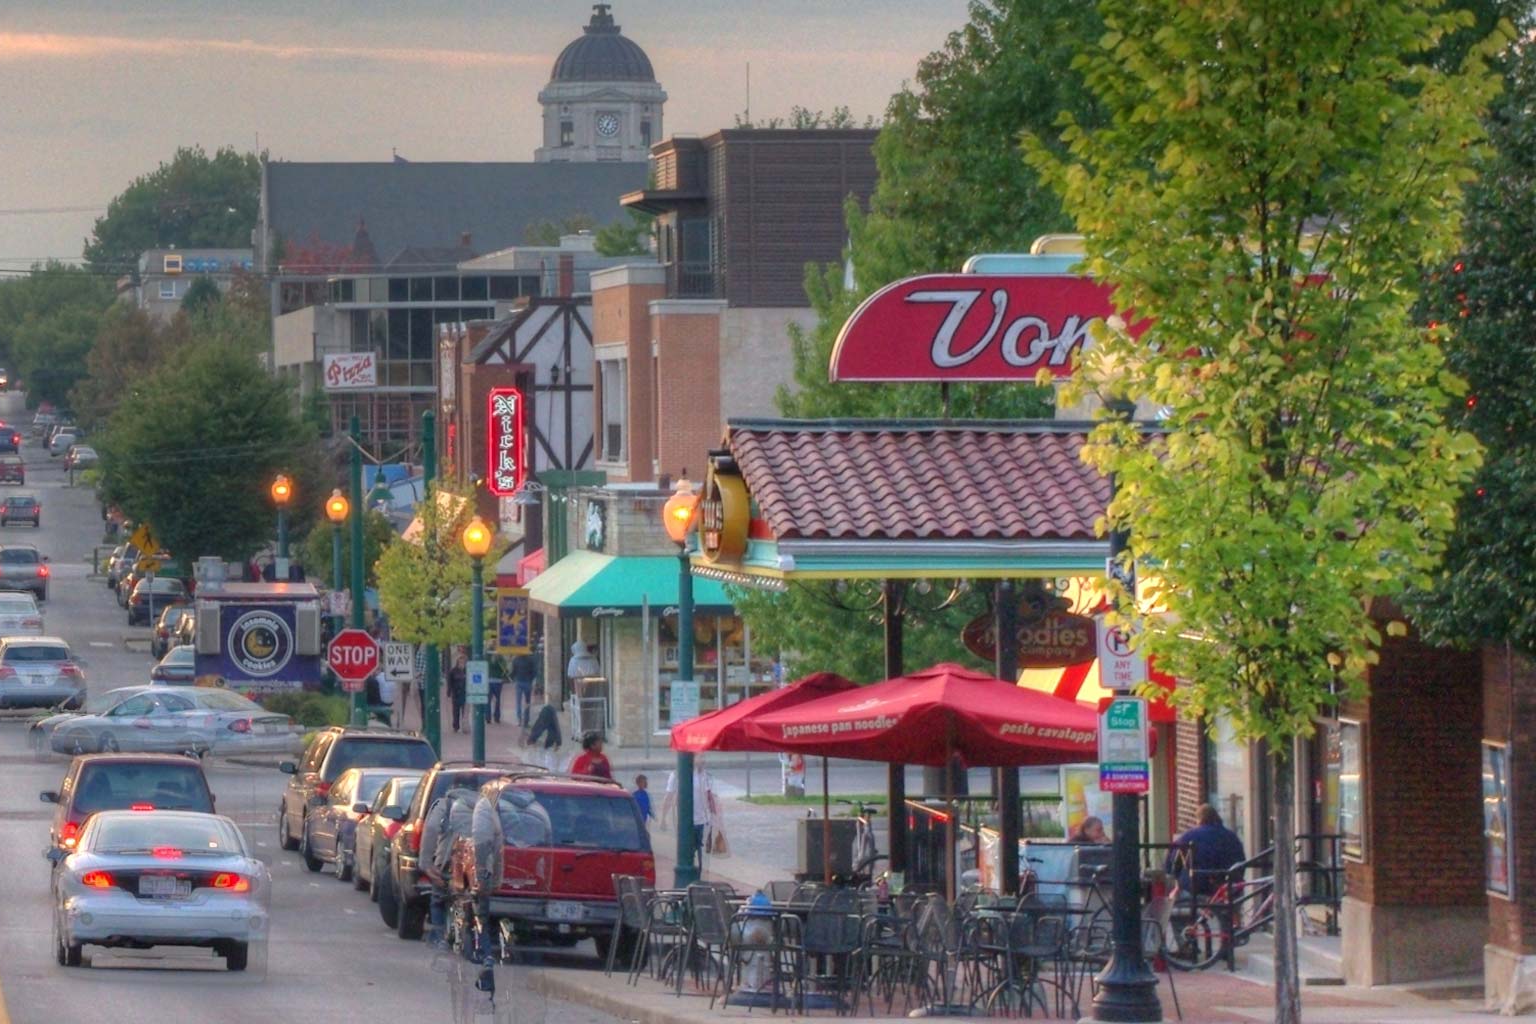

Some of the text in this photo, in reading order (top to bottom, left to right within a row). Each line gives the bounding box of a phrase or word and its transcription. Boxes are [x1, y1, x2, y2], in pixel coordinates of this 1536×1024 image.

[327, 356, 371, 385] Pizza
[493, 394, 517, 490] Nick's
[331, 646, 375, 665] STOP
[387, 645, 410, 655] ONE
[387, 656, 410, 666] WAY
[1115, 661, 1132, 670] ANY
[1114, 671, 1133, 681] TIME
[1000, 722, 1035, 735] pesto
[1111, 717, 1136, 728] Stop
[781, 722, 829, 738] japanese
[831, 720, 852, 734] pan
